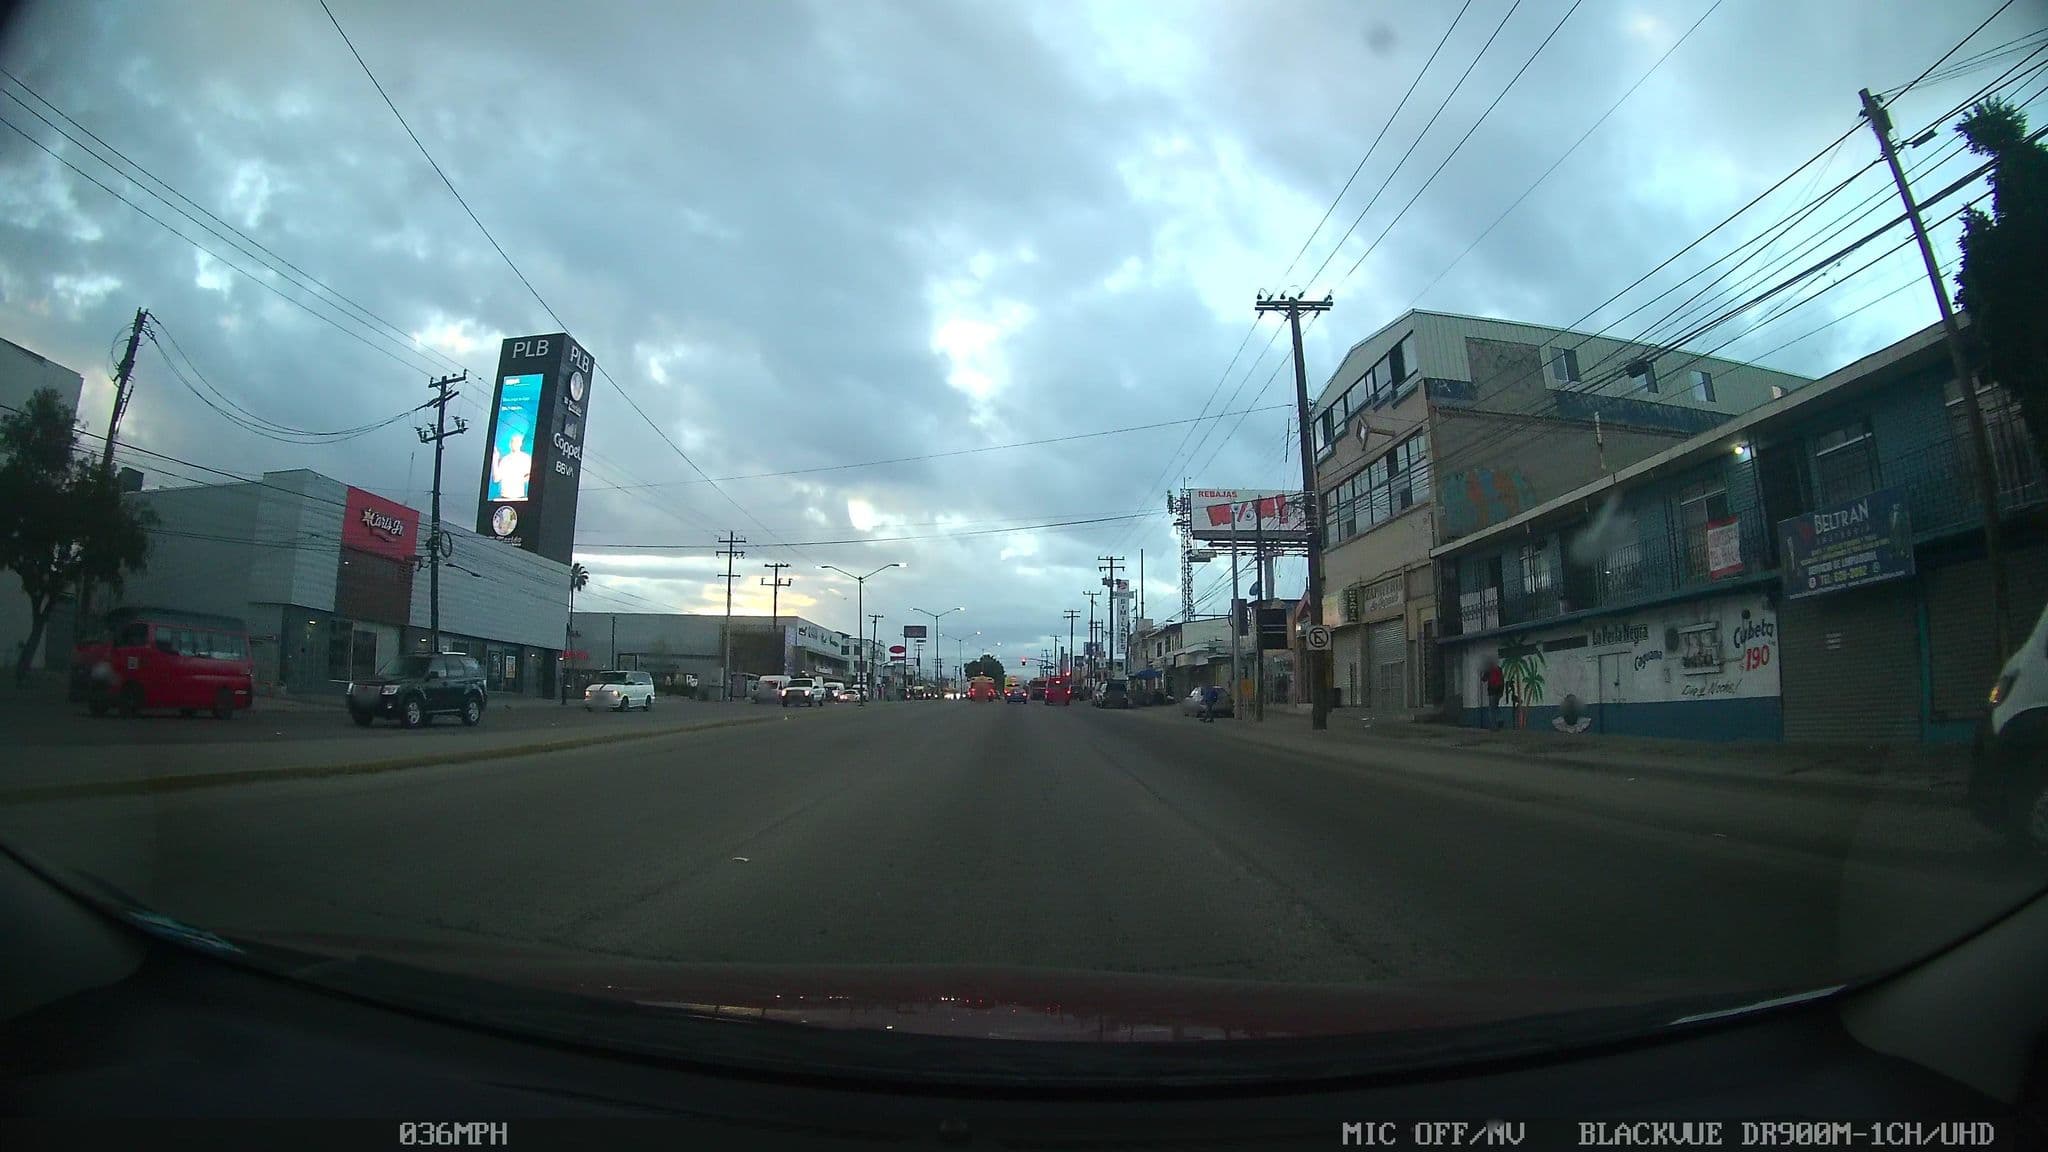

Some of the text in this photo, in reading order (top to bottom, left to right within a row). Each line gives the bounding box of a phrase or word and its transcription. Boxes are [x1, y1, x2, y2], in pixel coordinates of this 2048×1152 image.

[512, 339, 549, 359] PLB
[569, 345, 590, 373] PLB
[553, 432, 582, 461] Coppel
[555, 460, 574, 477] BBVA
[1198, 490, 1239, 498] REBAJAS
[1814, 499, 1869, 535] BELTRAN
[1733, 619, 1775, 649] Cubeta
